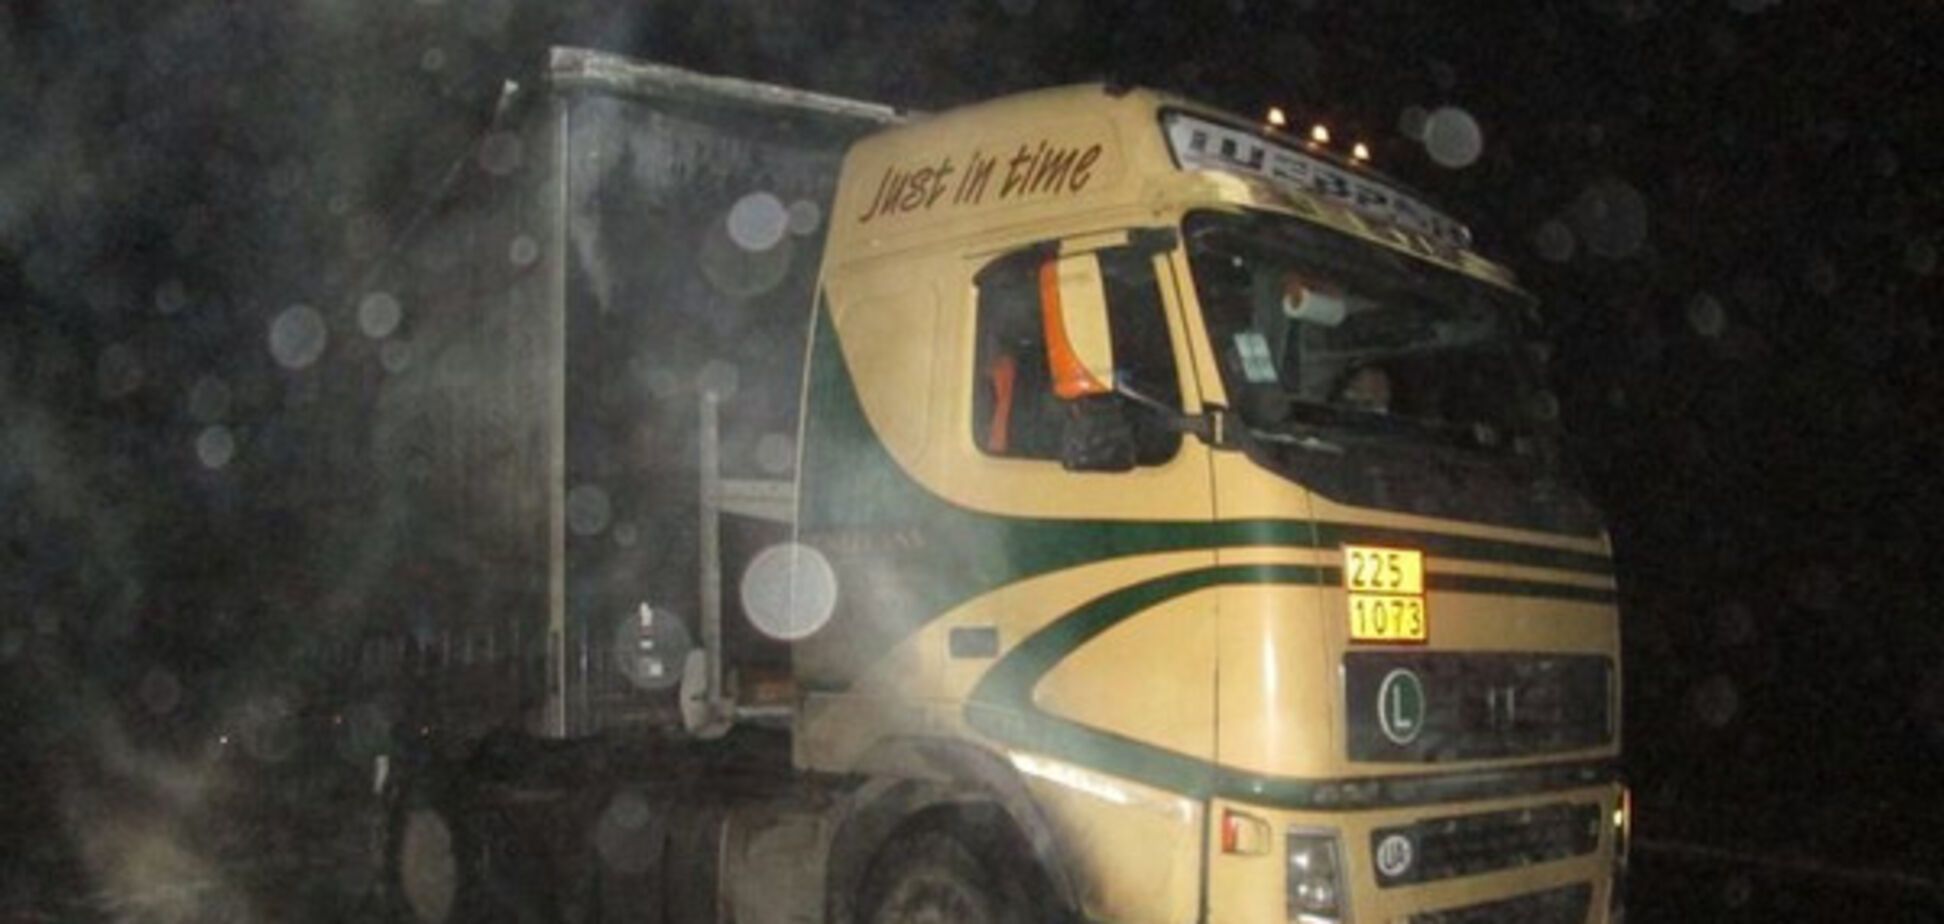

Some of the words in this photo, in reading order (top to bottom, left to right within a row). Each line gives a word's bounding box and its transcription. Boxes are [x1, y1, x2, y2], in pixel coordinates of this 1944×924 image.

[952, 150, 997, 204] in
[998, 138, 1103, 199] time
[1351, 551, 1404, 589] 225
[1356, 600, 1421, 636] 1073
[1392, 683, 1411, 729] L
